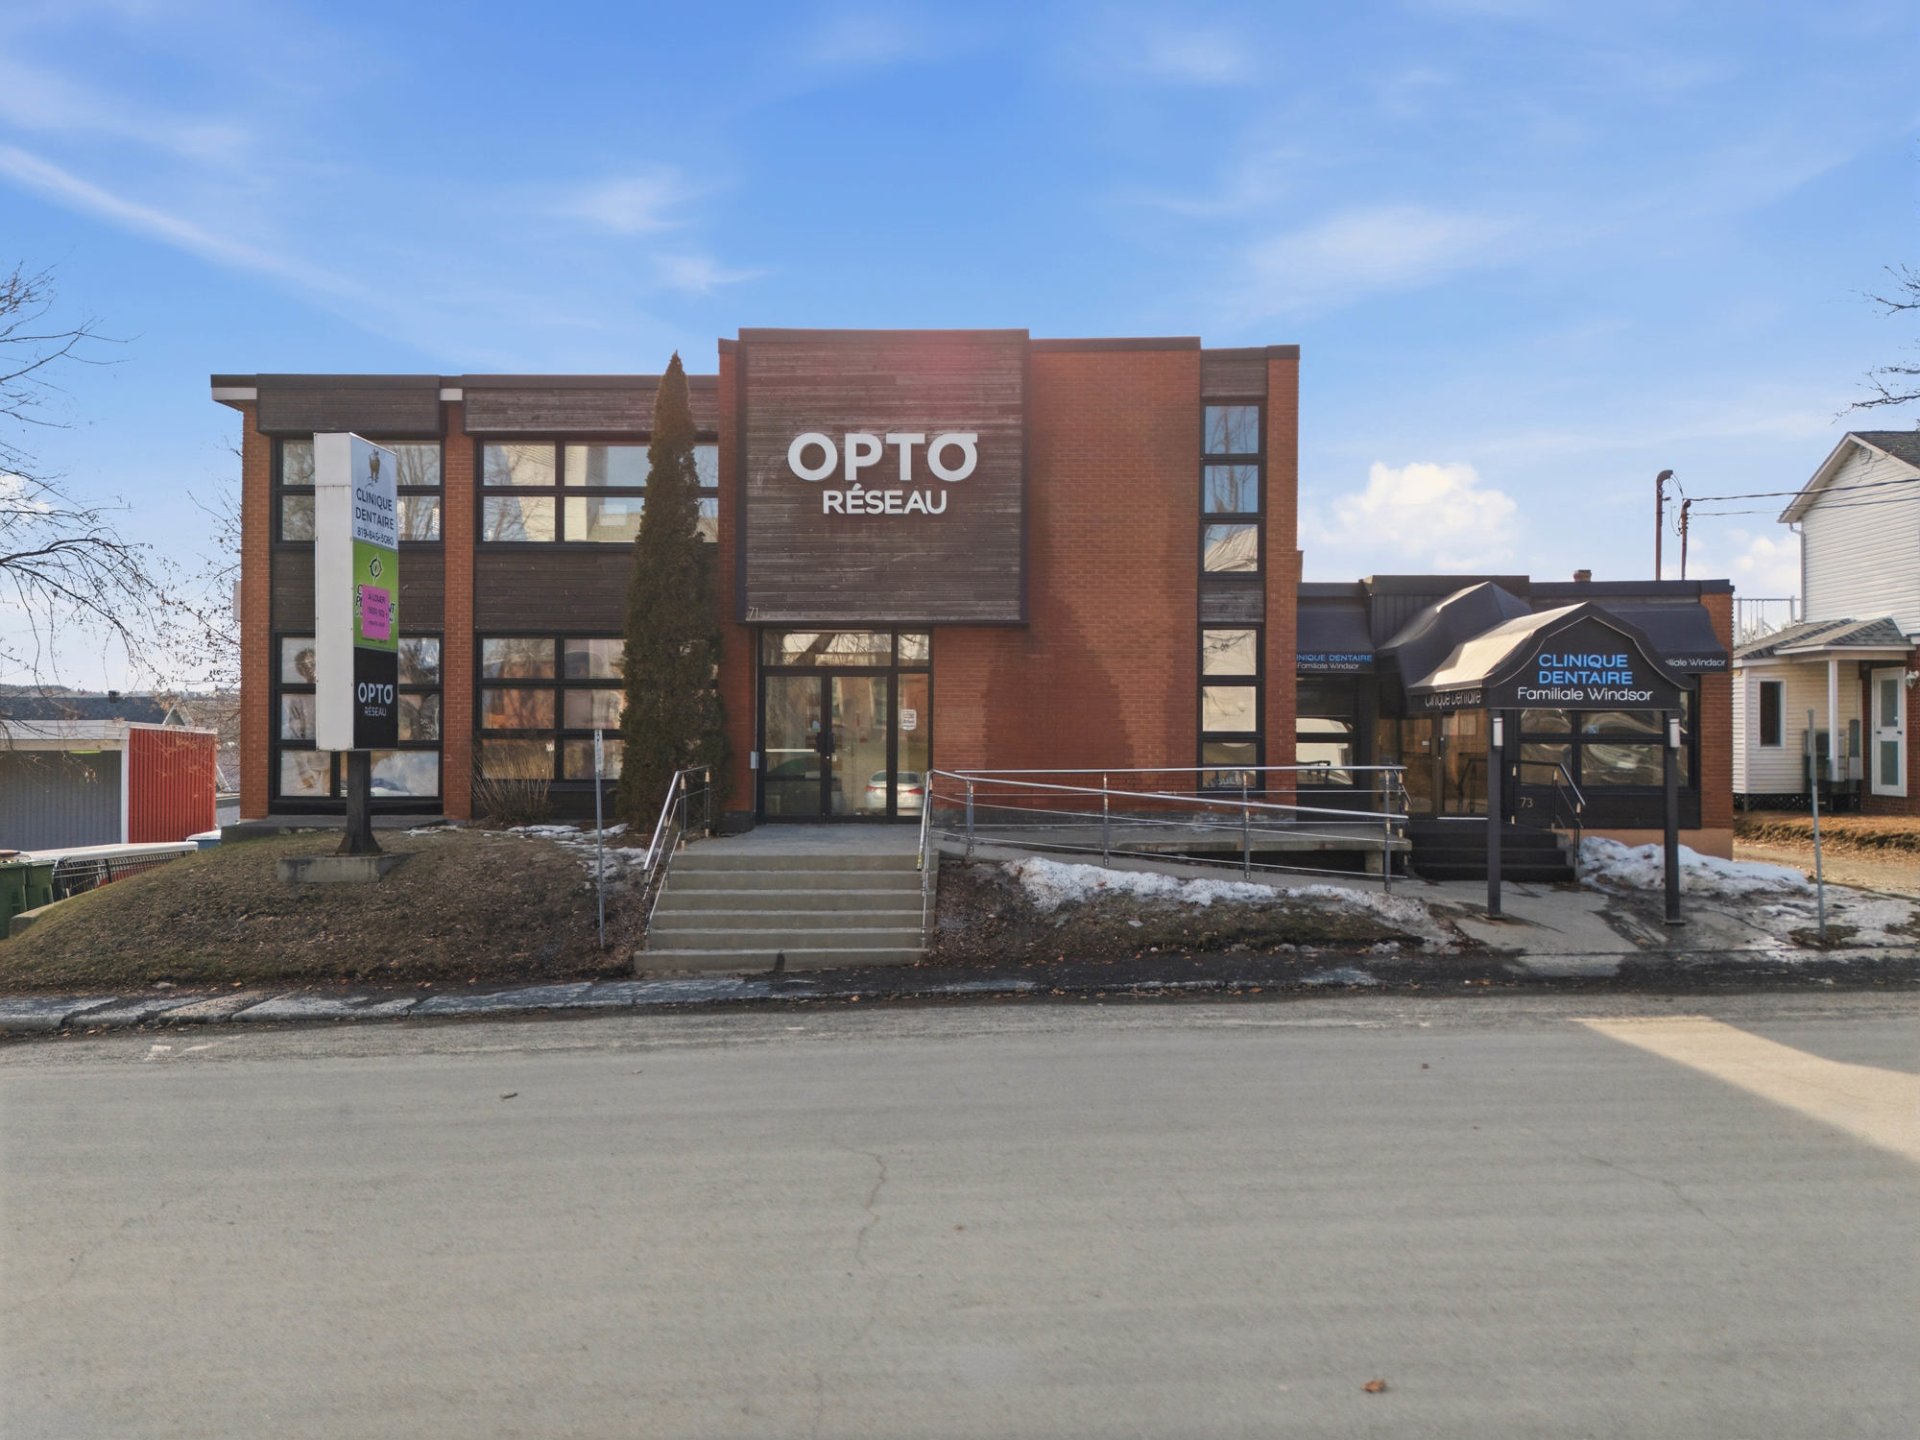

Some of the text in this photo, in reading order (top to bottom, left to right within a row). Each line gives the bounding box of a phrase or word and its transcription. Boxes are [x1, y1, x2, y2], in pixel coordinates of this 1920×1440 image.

[788, 432, 978, 481] OPTO
[356, 488, 392, 511] CLINIQUE
[823, 483, 947, 514] RÉSEAU
[355, 506, 395, 530] DENTAIRE
[1296, 654, 1373, 662] INIQUE DENTAIRE
[1538, 654, 1628, 668] CLINIQUE
[1688, 658, 1726, 667] Windsor
[1538, 671, 1633, 685] DENTAIRE
[358, 682, 394, 704] OPTO
[1517, 687, 1654, 701] Familiale Windsor
[1520, 796, 1534, 808] 73
